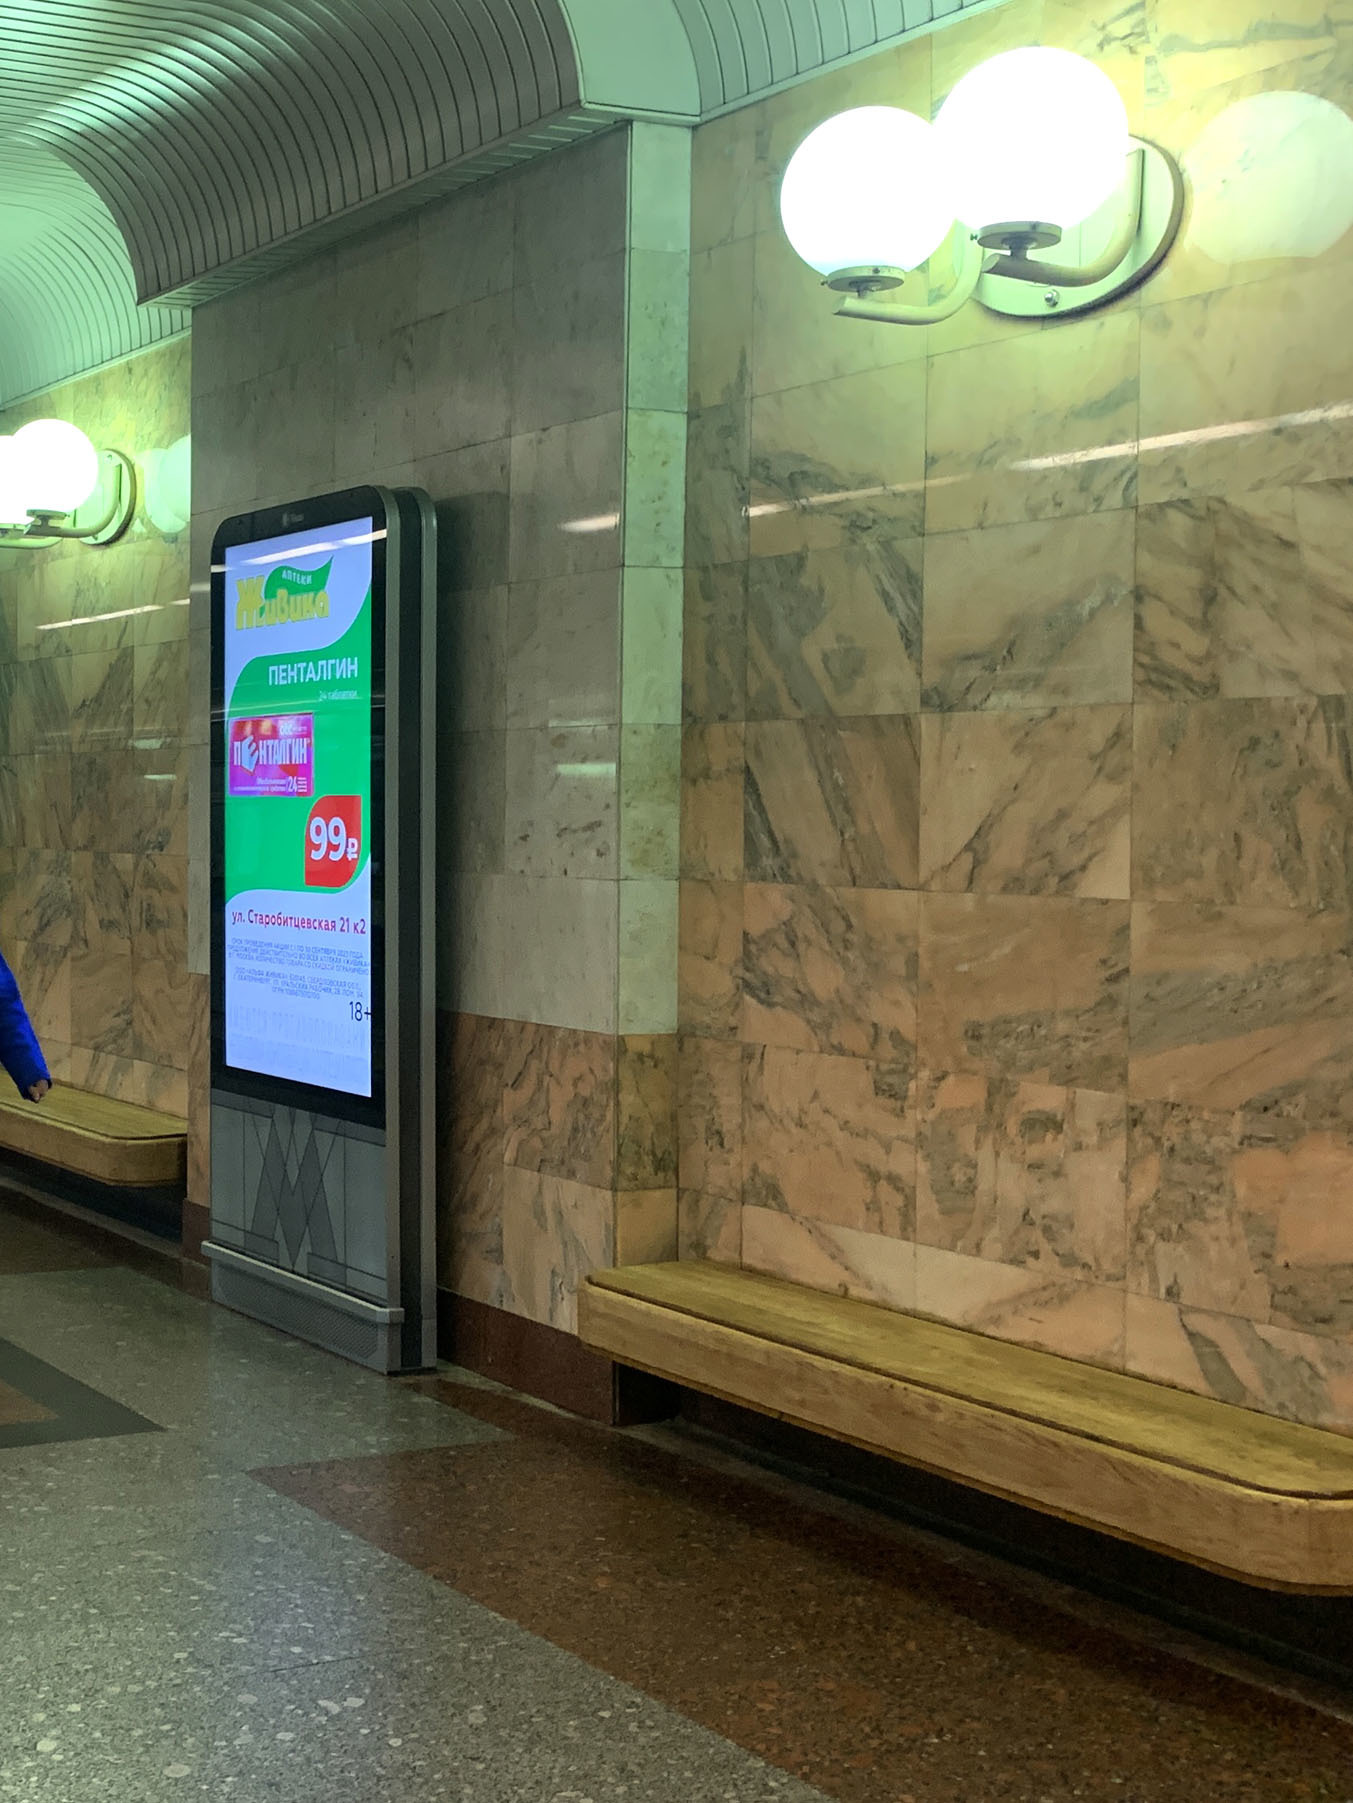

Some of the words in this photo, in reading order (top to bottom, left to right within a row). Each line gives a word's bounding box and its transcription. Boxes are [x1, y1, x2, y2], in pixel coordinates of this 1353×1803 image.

[282, 569, 312, 585] АПТЕКИ
[268, 657, 358, 686] ПЕНТАЛГИН
[232, 911, 246, 925] ул.
[248, 909, 337, 932] Старобитцевская
[340, 917, 350, 933] 21
[353, 918, 367, 935] к2
[349, 1001, 371, 1022] 18+
